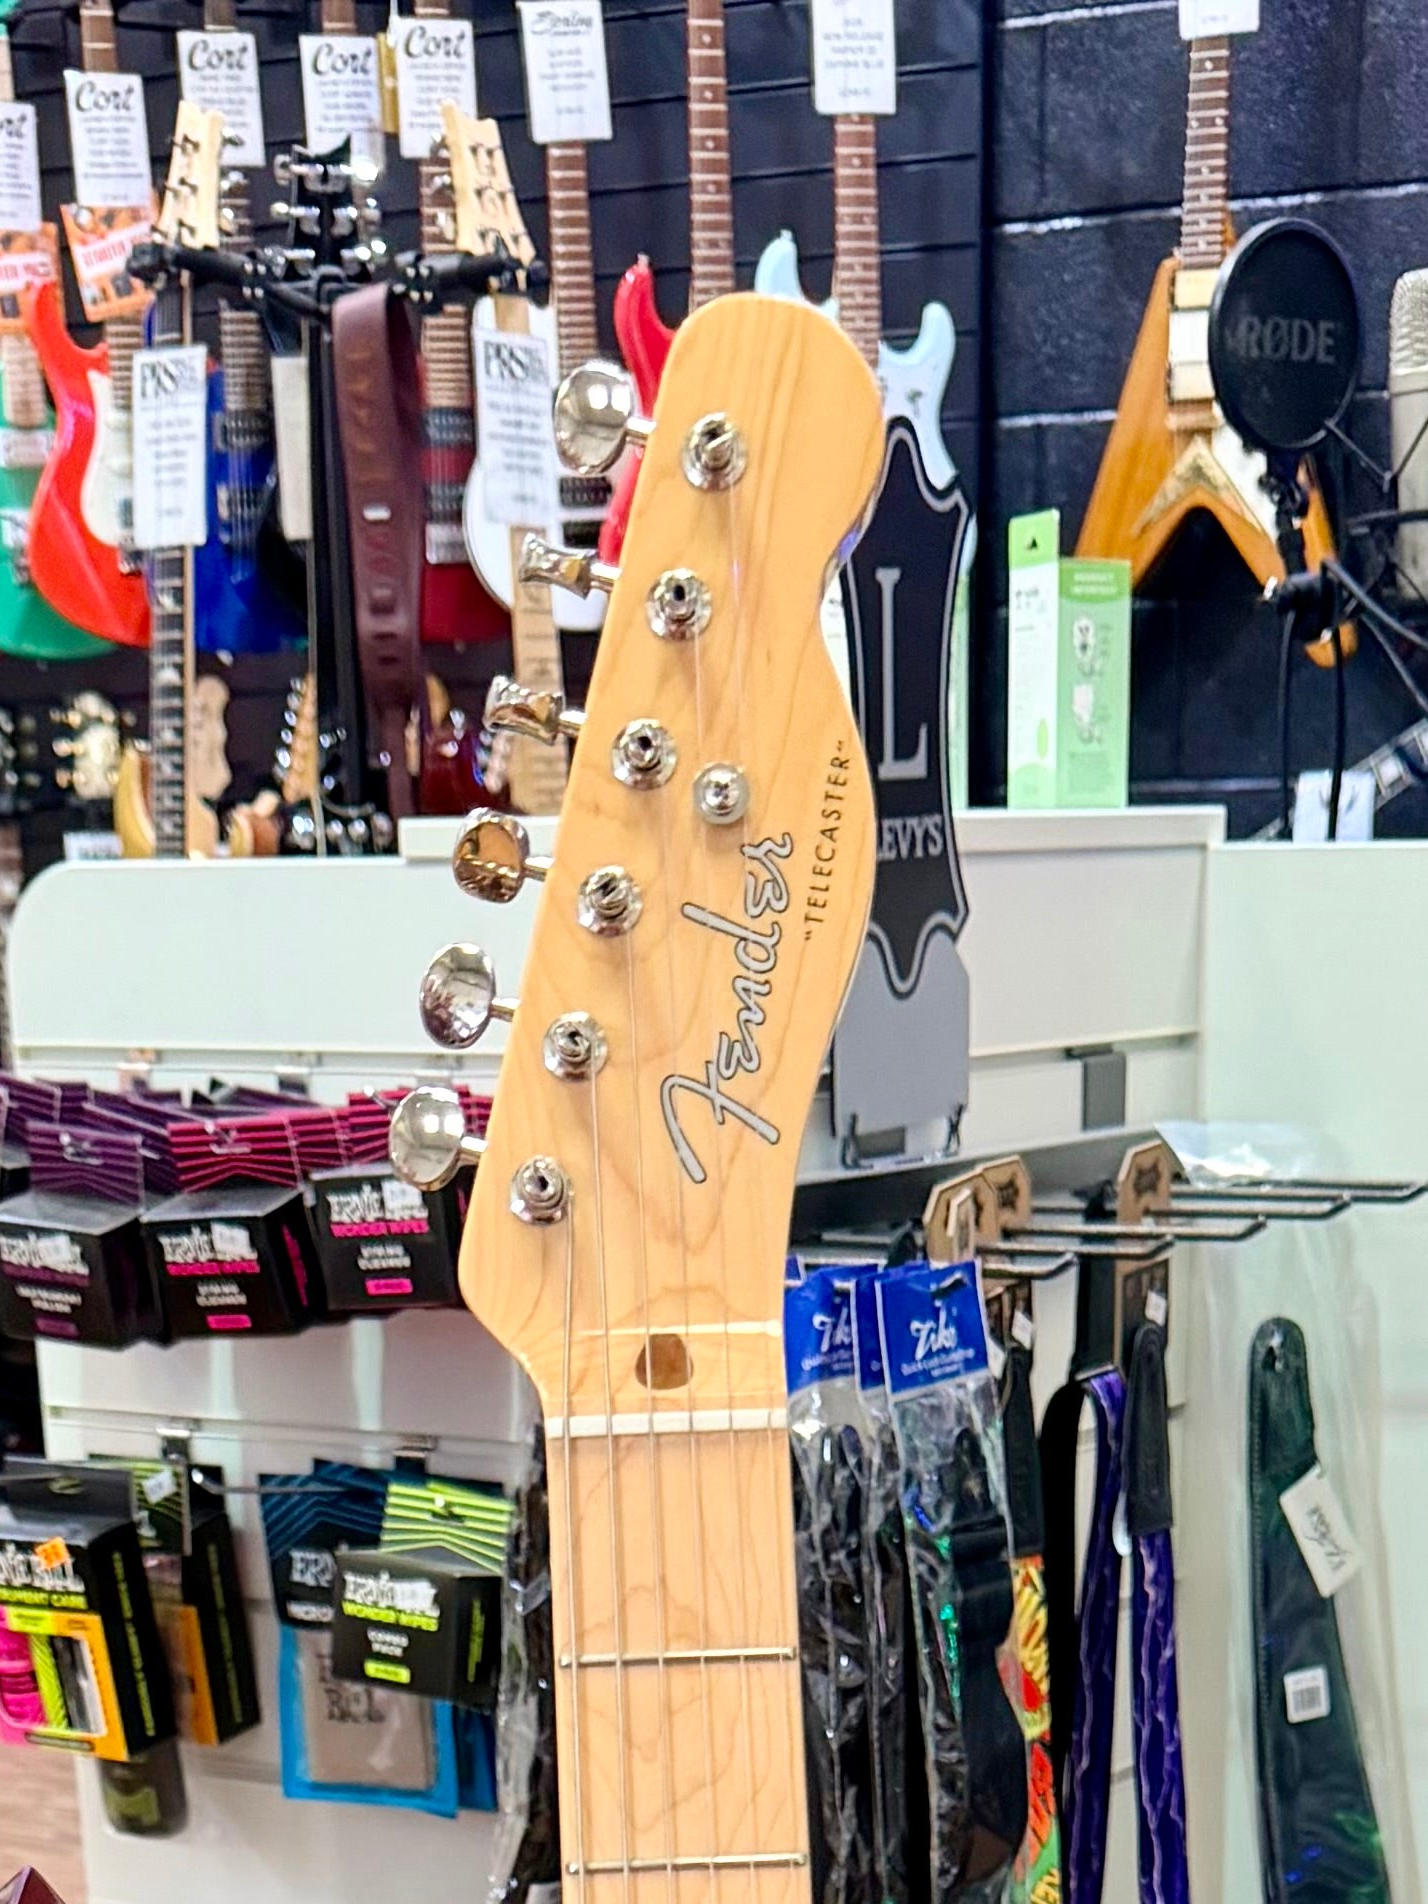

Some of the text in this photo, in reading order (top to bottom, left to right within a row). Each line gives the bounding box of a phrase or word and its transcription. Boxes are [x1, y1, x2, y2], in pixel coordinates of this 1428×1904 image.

[188, 41, 248, 73] Cort
[404, 27, 467, 58] Cort
[312, 43, 372, 77] Cort
[75, 80, 135, 113] Cort
[659, 830, 795, 1186] Fender
